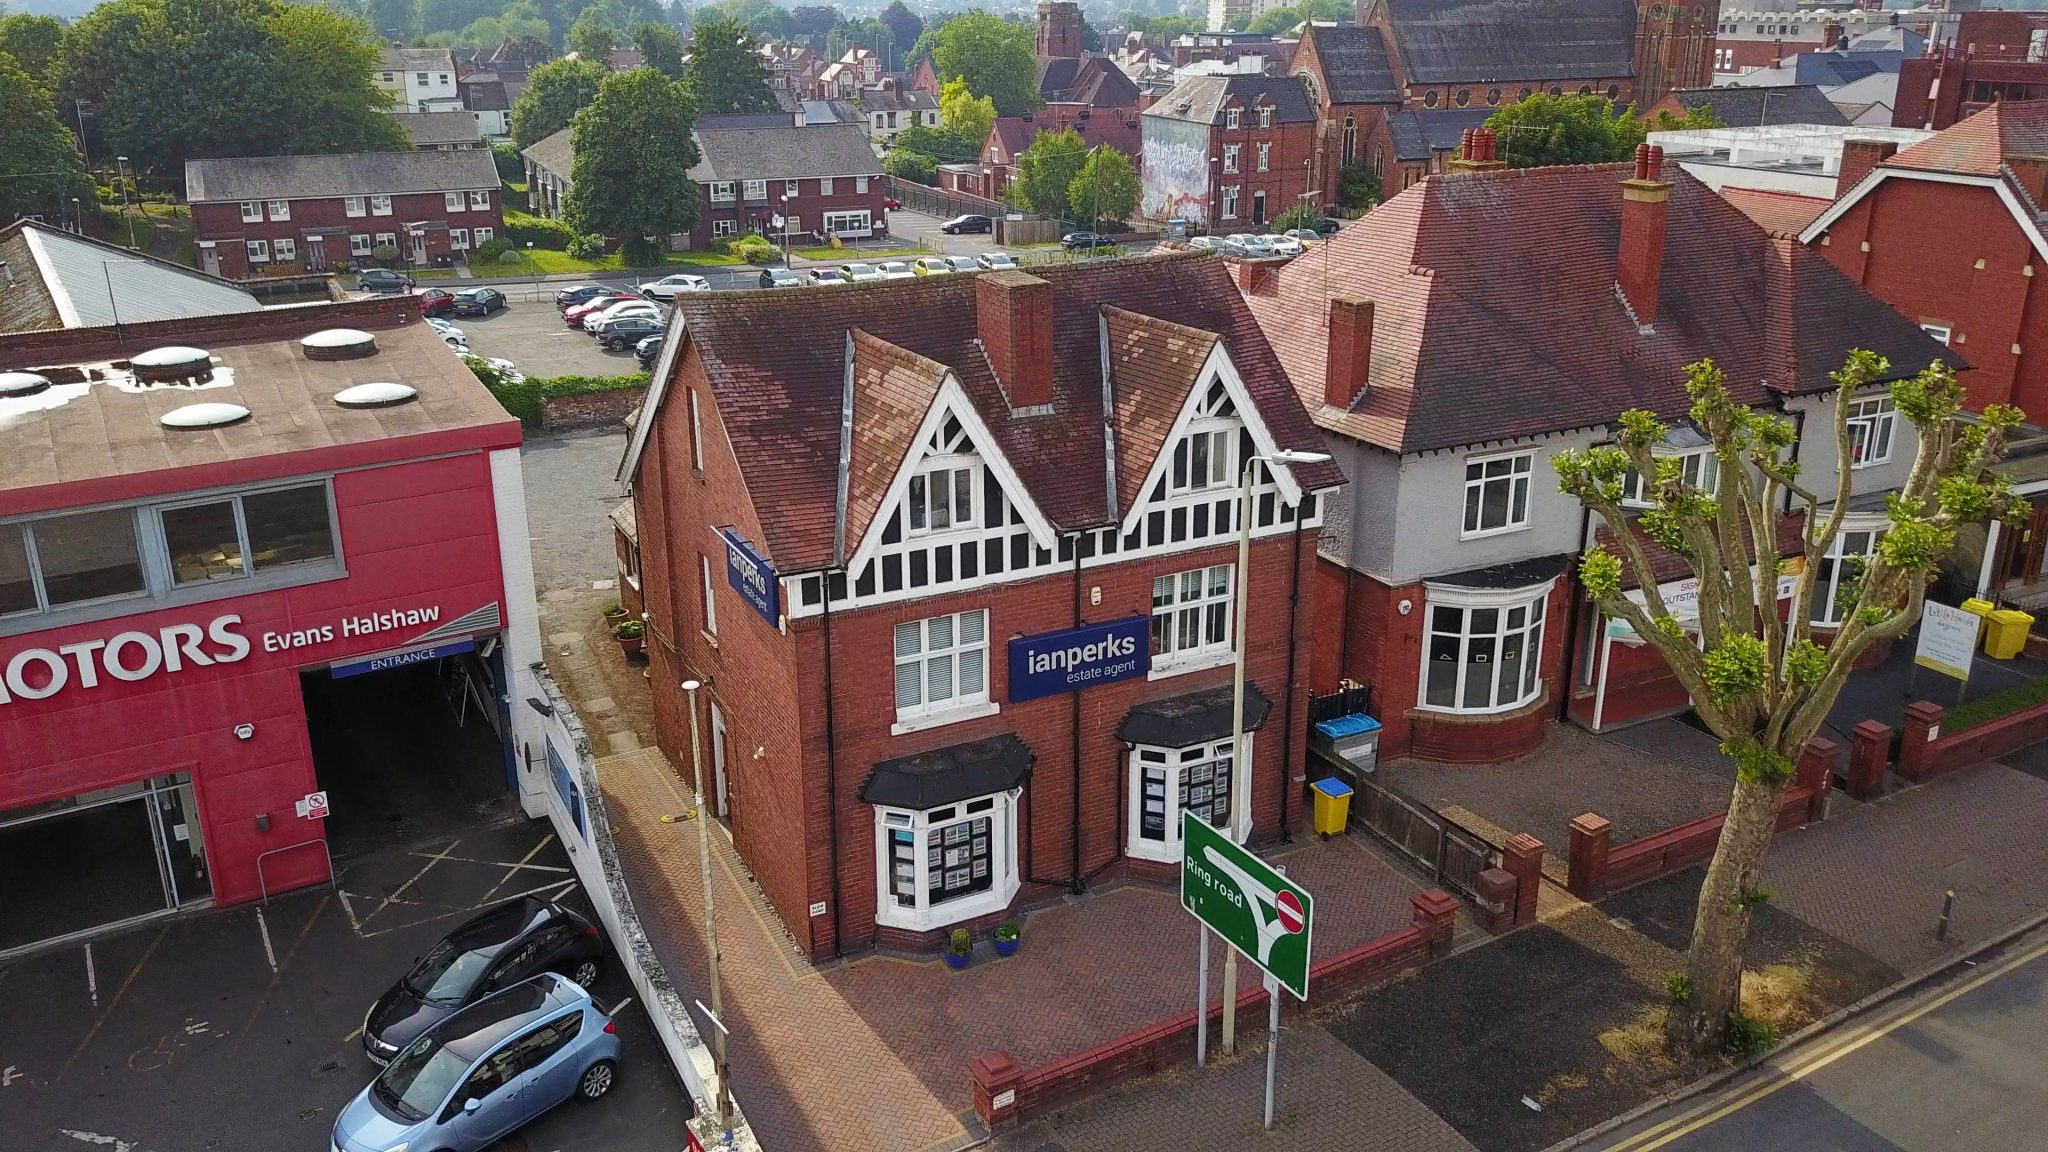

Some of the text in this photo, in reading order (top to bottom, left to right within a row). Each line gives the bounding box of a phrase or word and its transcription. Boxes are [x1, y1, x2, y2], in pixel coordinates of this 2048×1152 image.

[0, 614, 251, 705] OTORS
[263, 624, 334, 653] Evans
[342, 605, 440, 638] Halshaw
[370, 648, 436, 670] ENTRANCE
[1028, 633, 1136, 674] ianperks
[1066, 659, 1136, 683] estate agent
[1186, 855, 1211, 887] Ring
[1214, 877, 1243, 909] road
